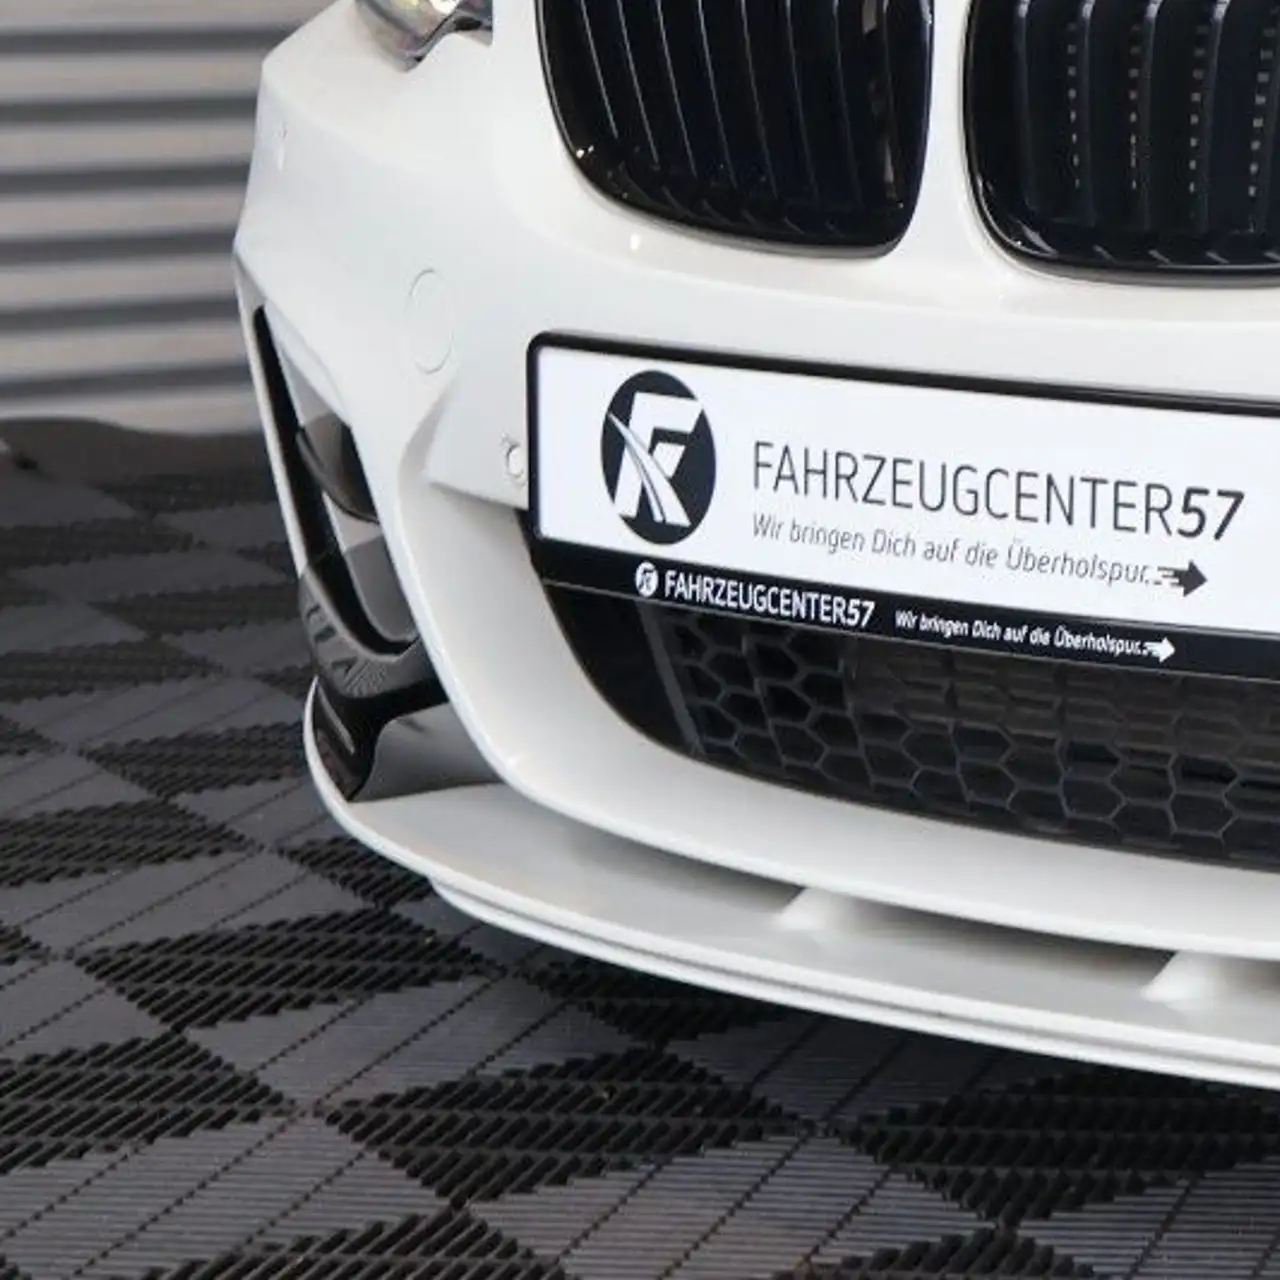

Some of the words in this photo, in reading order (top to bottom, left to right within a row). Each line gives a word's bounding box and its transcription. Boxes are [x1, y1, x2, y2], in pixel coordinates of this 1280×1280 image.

[752, 440, 1245, 541] FAHRZEUGCENTER57
[752, 511, 784, 540] Wir
[790, 519, 865, 555] bringen
[872, 529, 916, 558] Dich
[924, 538, 957, 564] auf
[965, 541, 998, 569] die
[664, 570, 874, 627] FAHRZEUGCENTER57
[894, 609, 919, 629] Wir
[920, 612, 969, 638] bringen
[972, 618, 1001, 640] Dich
[1003, 625, 1028, 646] auf
[1030, 626, 1051, 647] die
